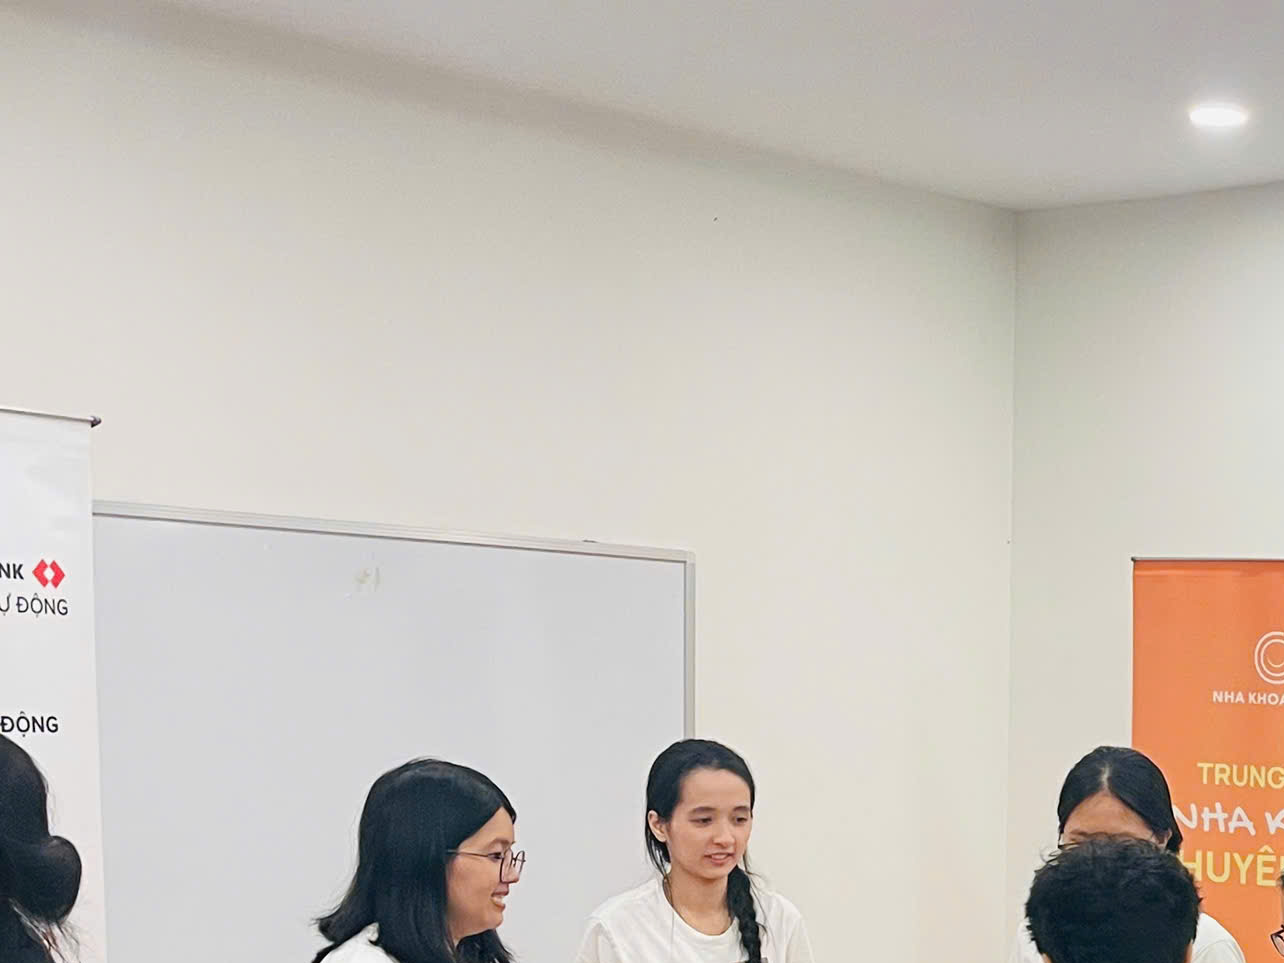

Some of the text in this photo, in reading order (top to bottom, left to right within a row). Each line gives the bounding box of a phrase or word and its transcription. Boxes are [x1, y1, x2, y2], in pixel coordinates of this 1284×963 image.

[16, 592, 68, 618] ĐỘNG
[1212, 690, 1245, 704] NHA
[0, 710, 59, 738] ĐỘNG
[1172, 801, 1256, 836] NHA
